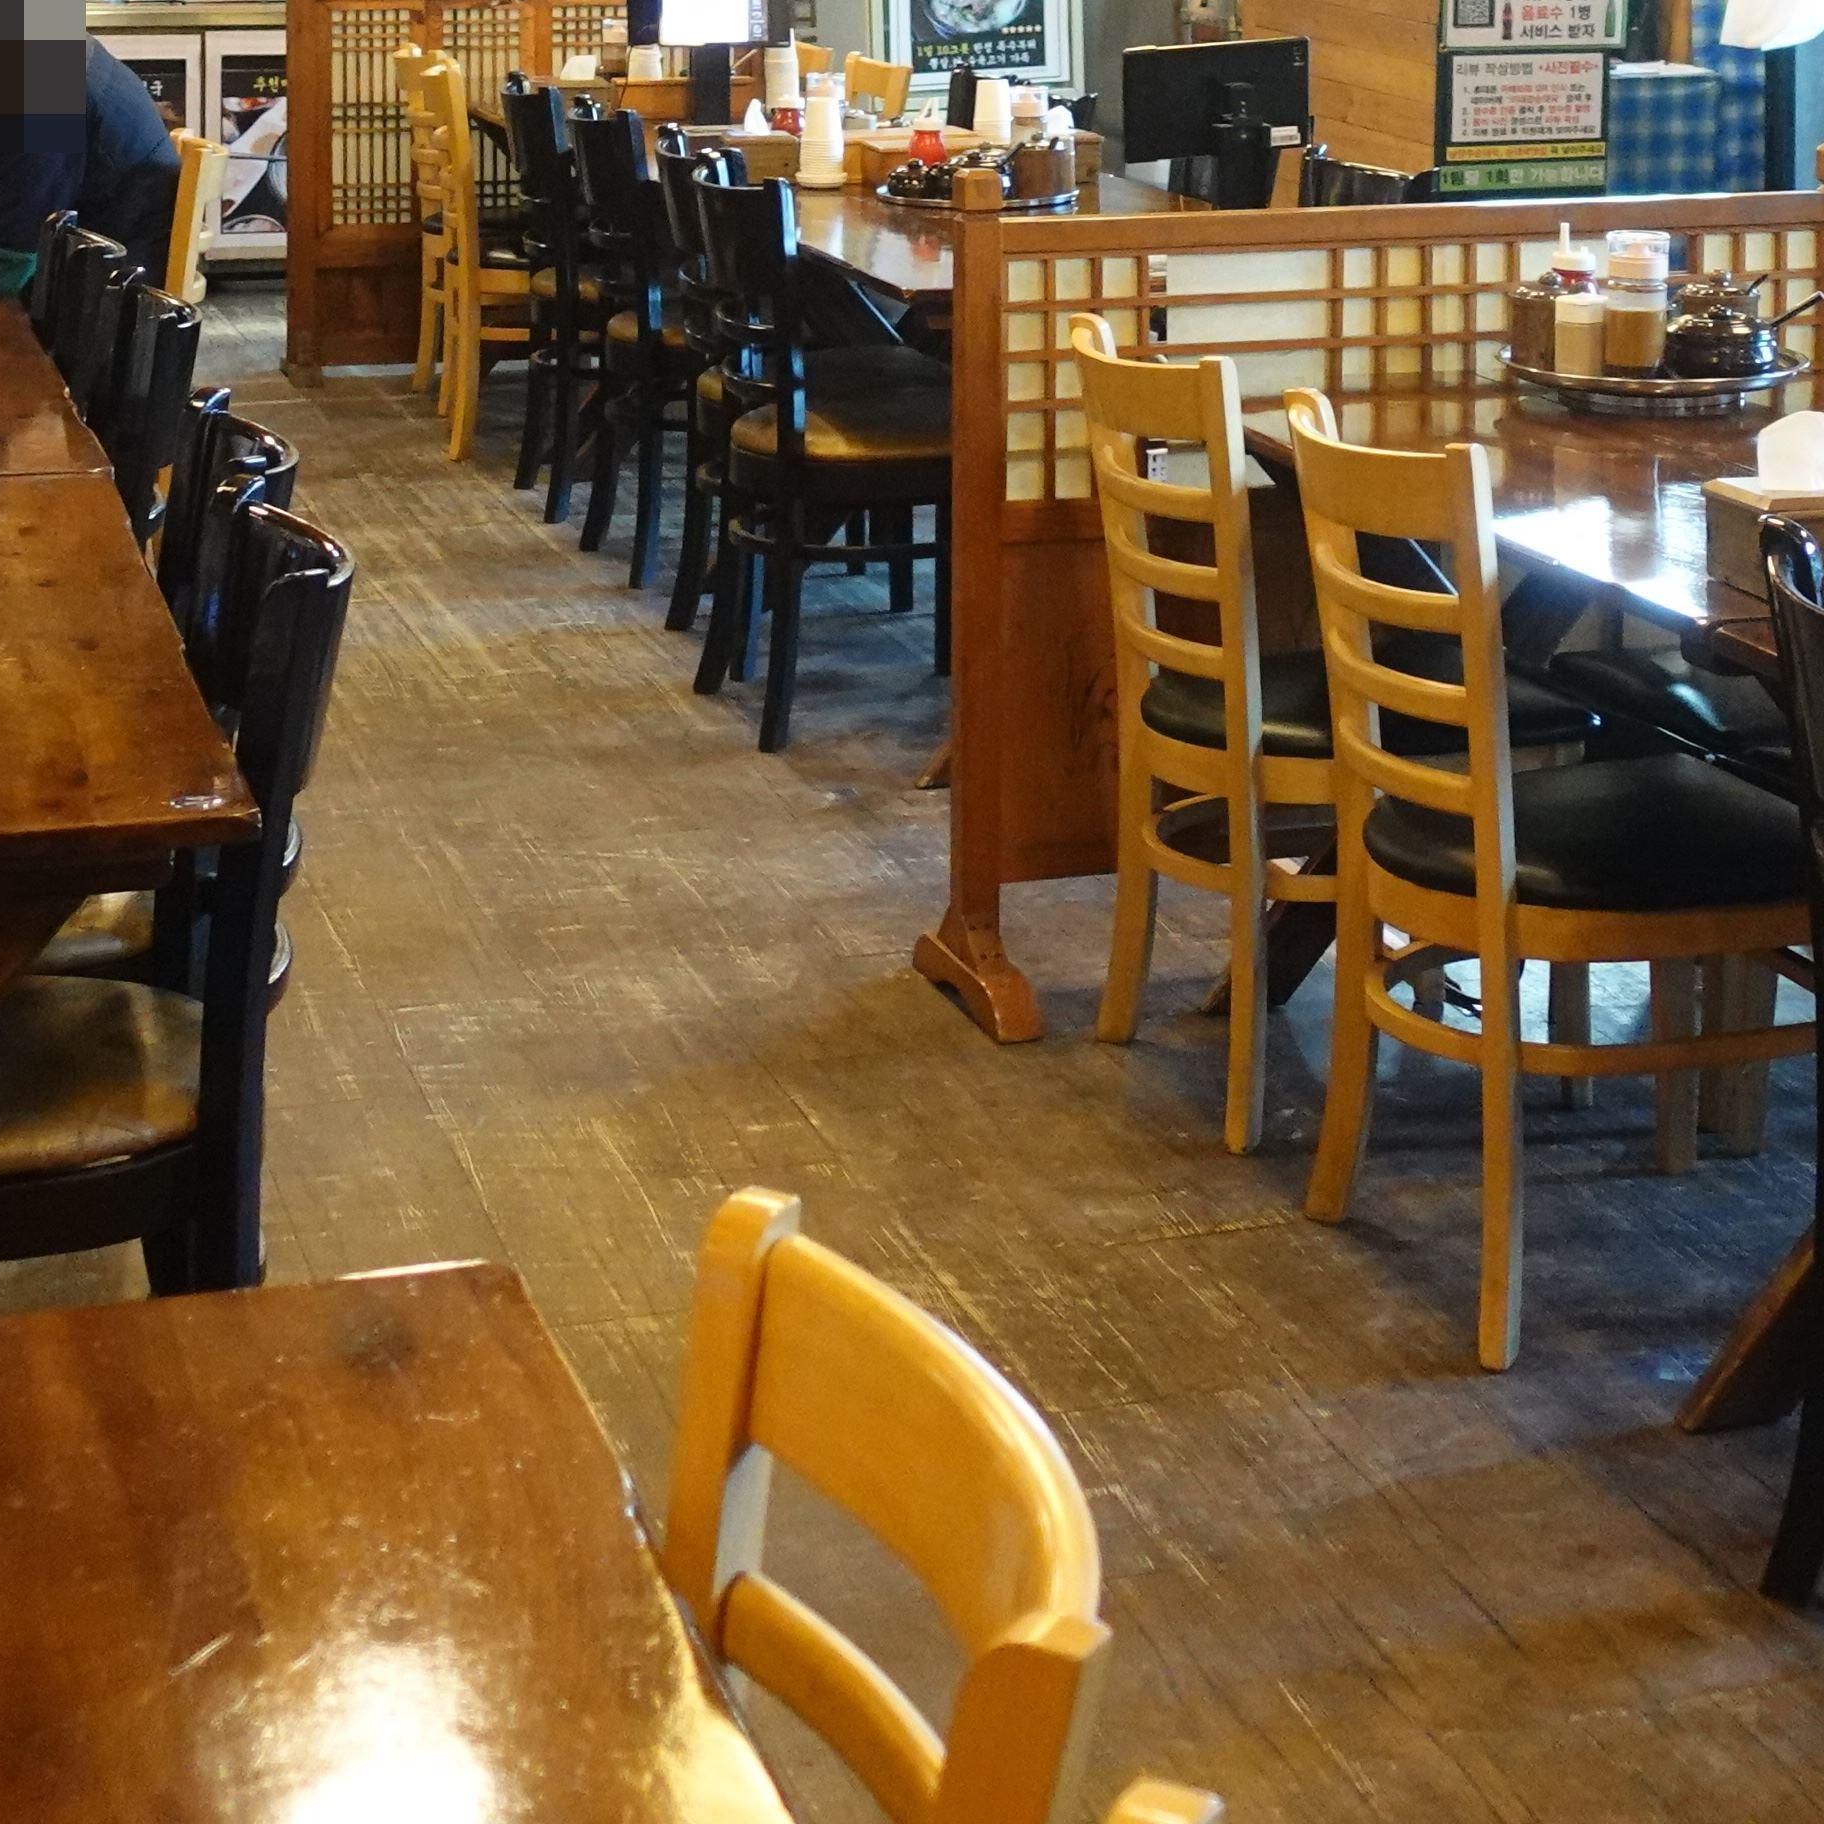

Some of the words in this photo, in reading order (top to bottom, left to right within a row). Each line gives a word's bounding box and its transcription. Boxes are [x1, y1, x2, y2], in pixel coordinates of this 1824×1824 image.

[1521, 5, 1564, 20] 음료수
[1570, 5, 1591, 19] 1병
[1520, 25, 1563, 40] 서비스
[1568, 23, 1596, 38] 받자
[1456, 63, 1480, 76] 리뷰
[1485, 62, 1534, 76] 작성방법
